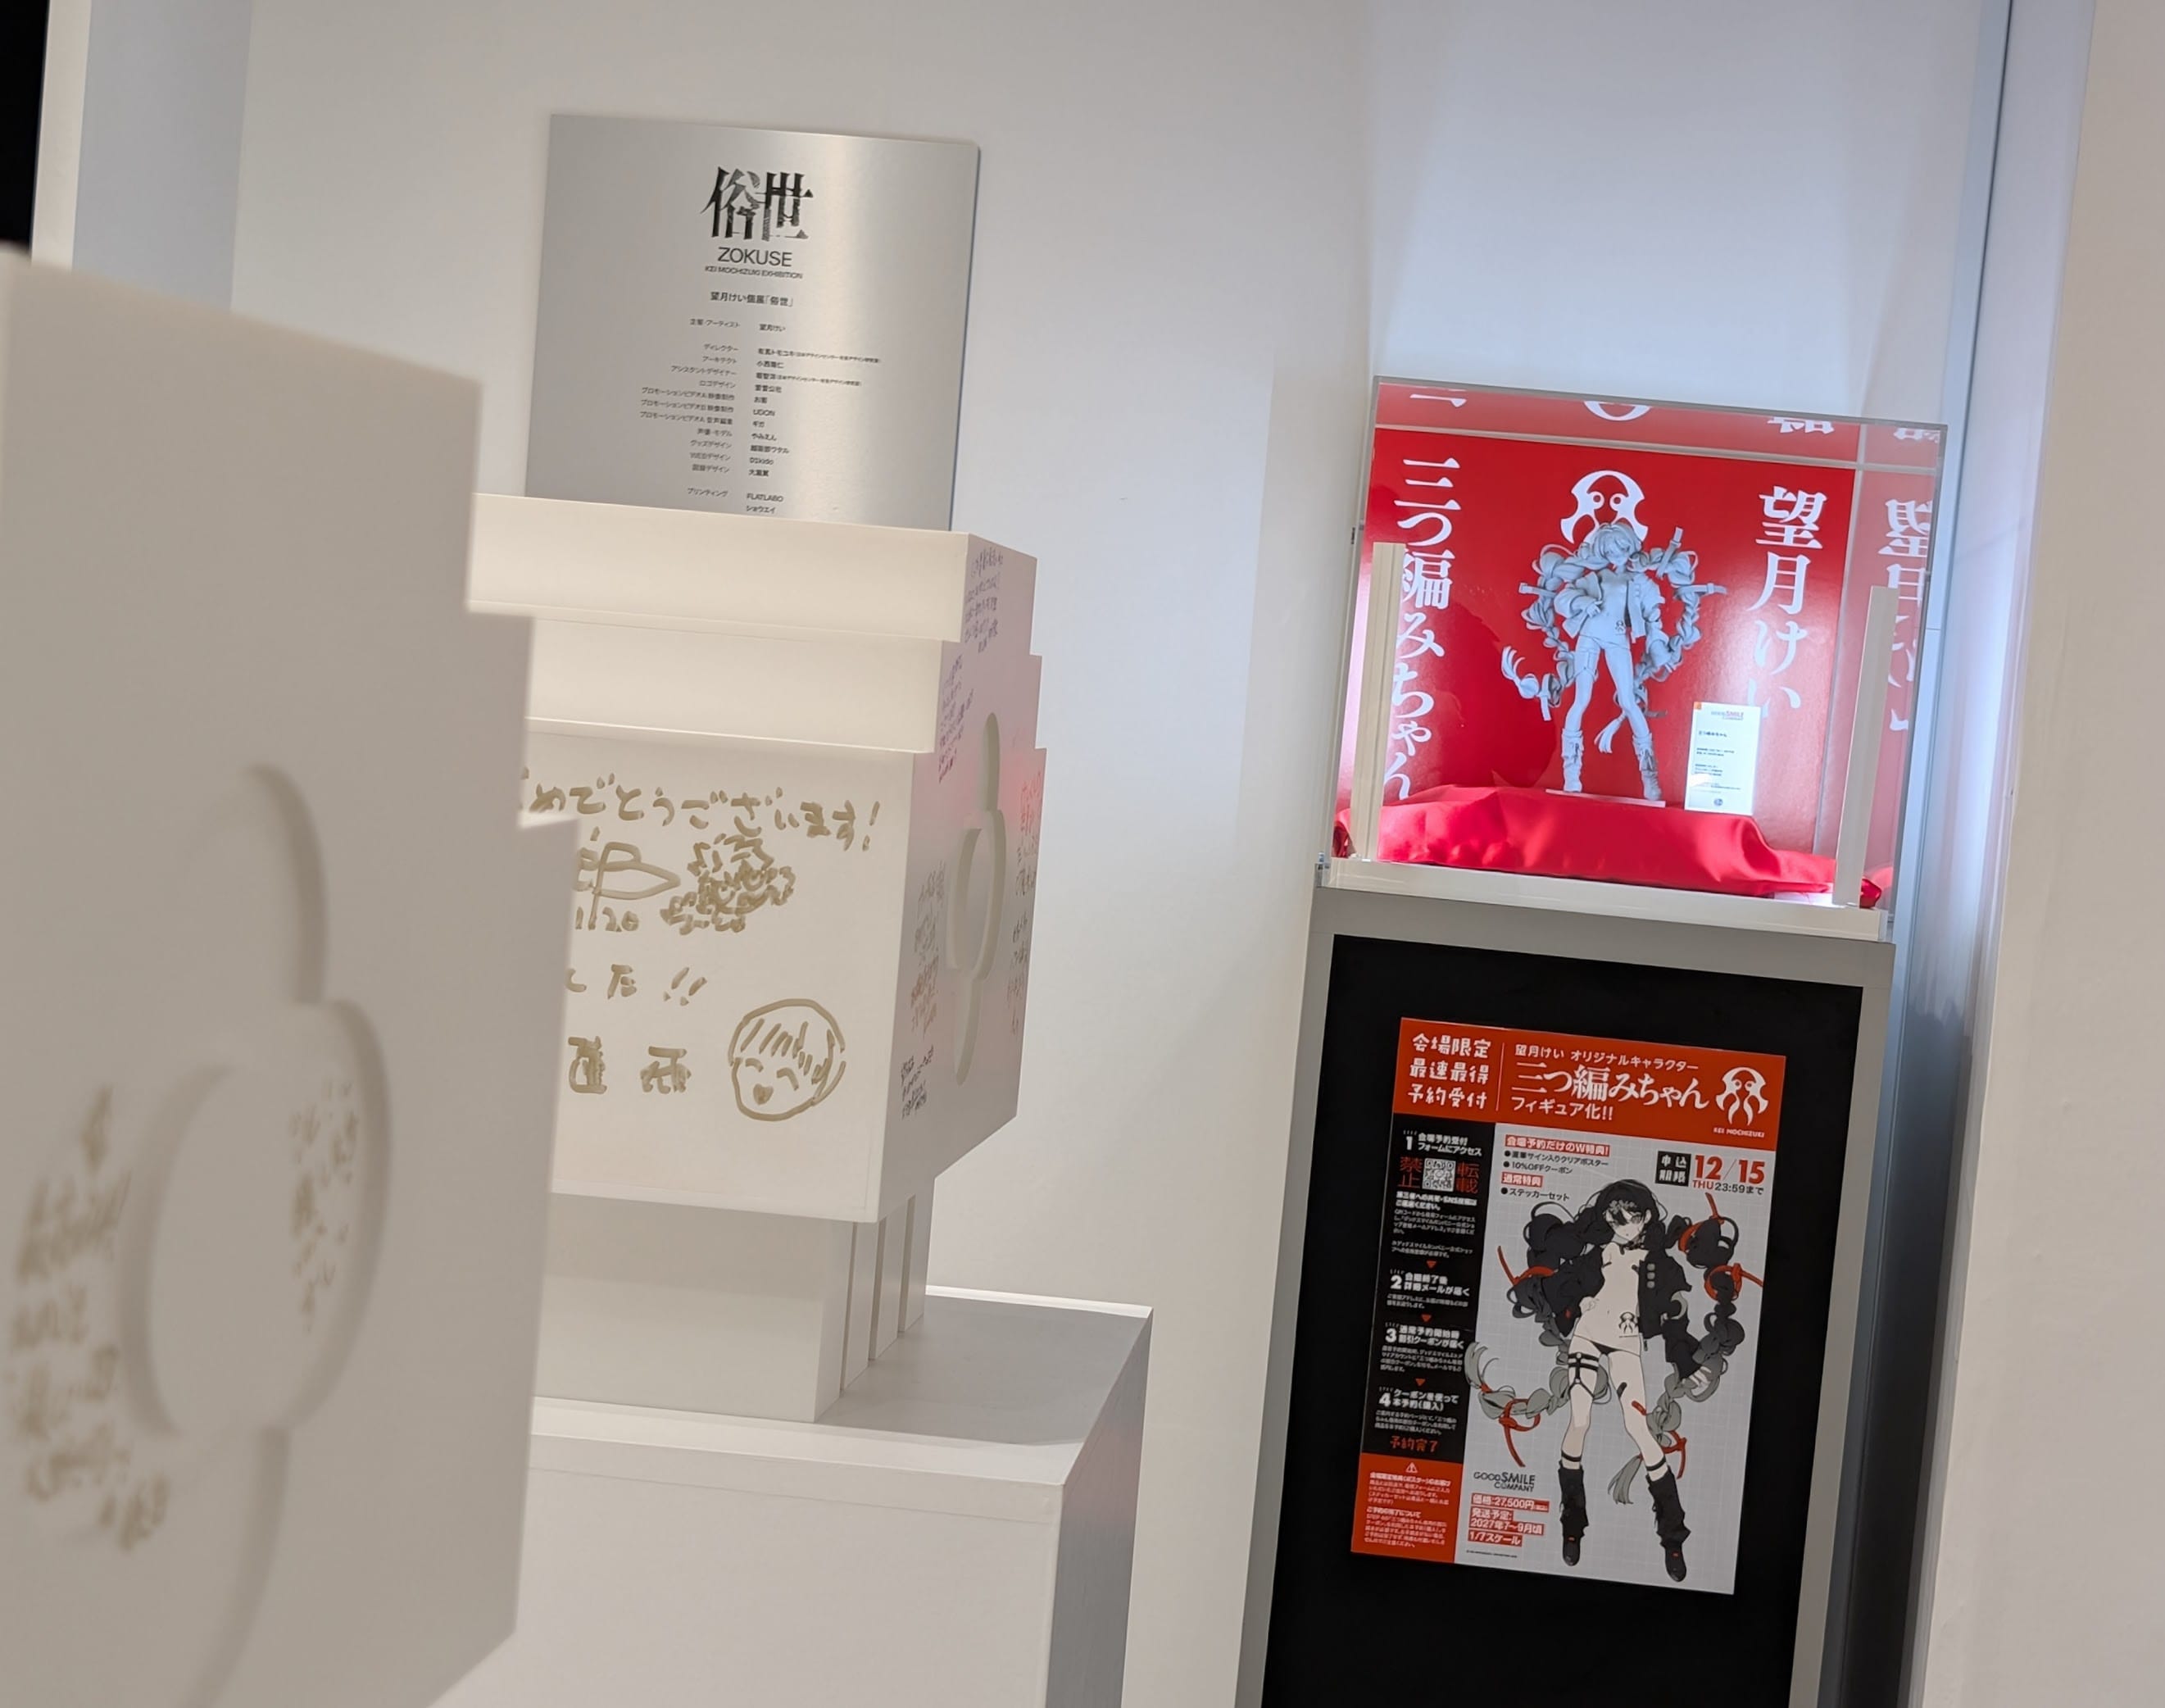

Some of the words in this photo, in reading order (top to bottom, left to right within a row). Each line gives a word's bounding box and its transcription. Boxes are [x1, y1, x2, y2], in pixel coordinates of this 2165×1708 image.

[701, 166, 814, 241] 俗世
[718, 247, 792, 266] ZOKUSE
[719, 266, 760, 276] MOCHIZUKI
[761, 270, 803, 279] EXHIBITION
[710, 292, 794, 307] 望月けい個展「俗世」
[747, 493, 784, 502] FLATLABO
[746, 505, 776, 514] ショウエイ
[523, 767, 881, 851] めでとうございます!
[1412, 1033, 1491, 1059] 会場限定
[1514, 1044, 1565, 1060] 望月けい
[1570, 1050, 1700, 1073] オリジナルキャラクター
[1409, 1057, 1489, 1085] 最速最得
[1511, 1061, 1710, 1110] 三つ編みちゃん
[1408, 1083, 1487, 1110] 予約受付
[1510, 1097, 1614, 1121] フィギュア化!!
[1406, 1136, 1413, 1151] 1
[1418, 1142, 1482, 1156] フォームにアクセス
[1512, 1161, 1573, 1174] 10%OFFクーポン
[1661, 1154, 1687, 1169] 申込
[1695, 1154, 1766, 1184] 12/15
[1509, 1188, 1570, 1201] ステッカーセット
[1391, 1274, 1402, 1290] 2
[1385, 1328, 1396, 1343] 3
[1378, 1392, 1391, 1407] 4
[1394, 1388, 1459, 1404] クーポンを使って
[1390, 1435, 1438, 1452] 予約完了
[1494, 1482, 1535, 1492] COMPANY
[1468, 1532, 1522, 1546] 1/7スケール
